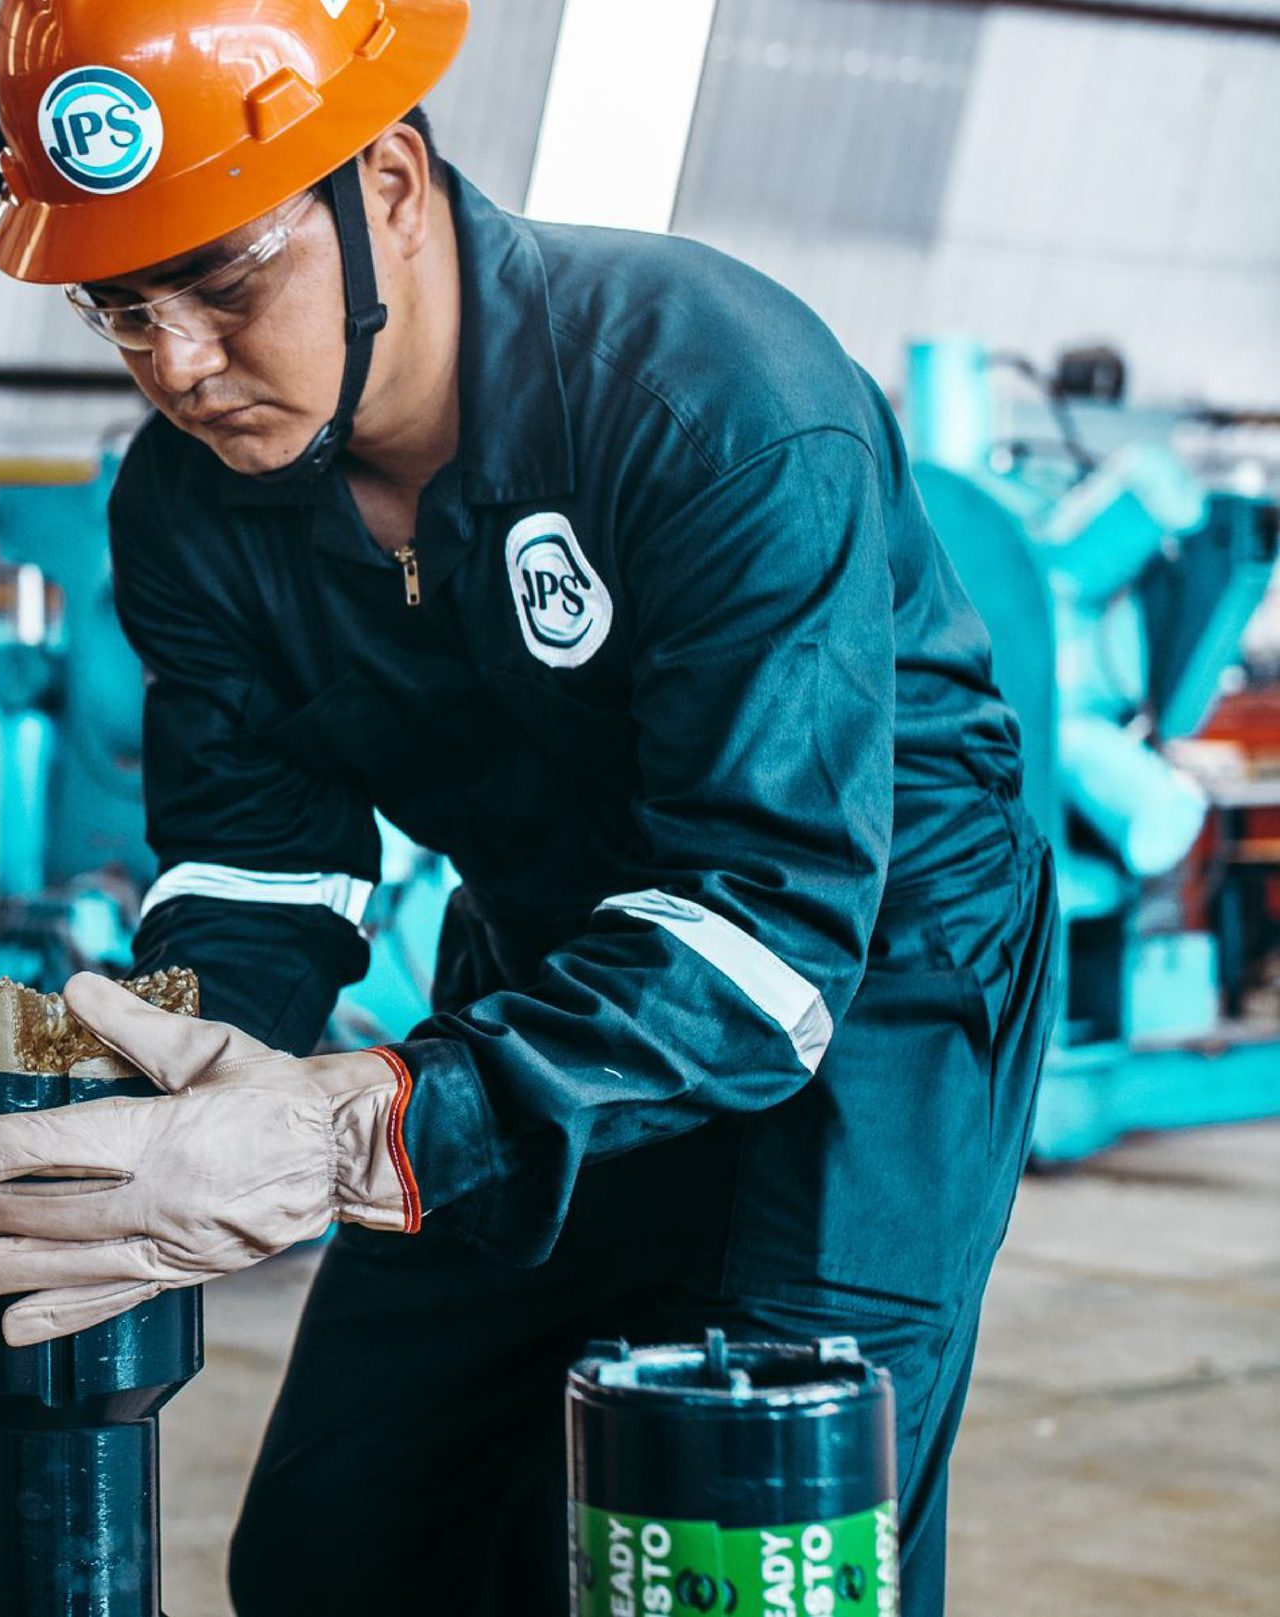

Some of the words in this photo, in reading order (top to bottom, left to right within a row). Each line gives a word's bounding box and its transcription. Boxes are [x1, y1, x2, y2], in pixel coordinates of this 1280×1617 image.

[49, 104, 142, 159] JPS
[521, 567, 585, 616] JPS
[801, 1524, 836, 1617] STO
